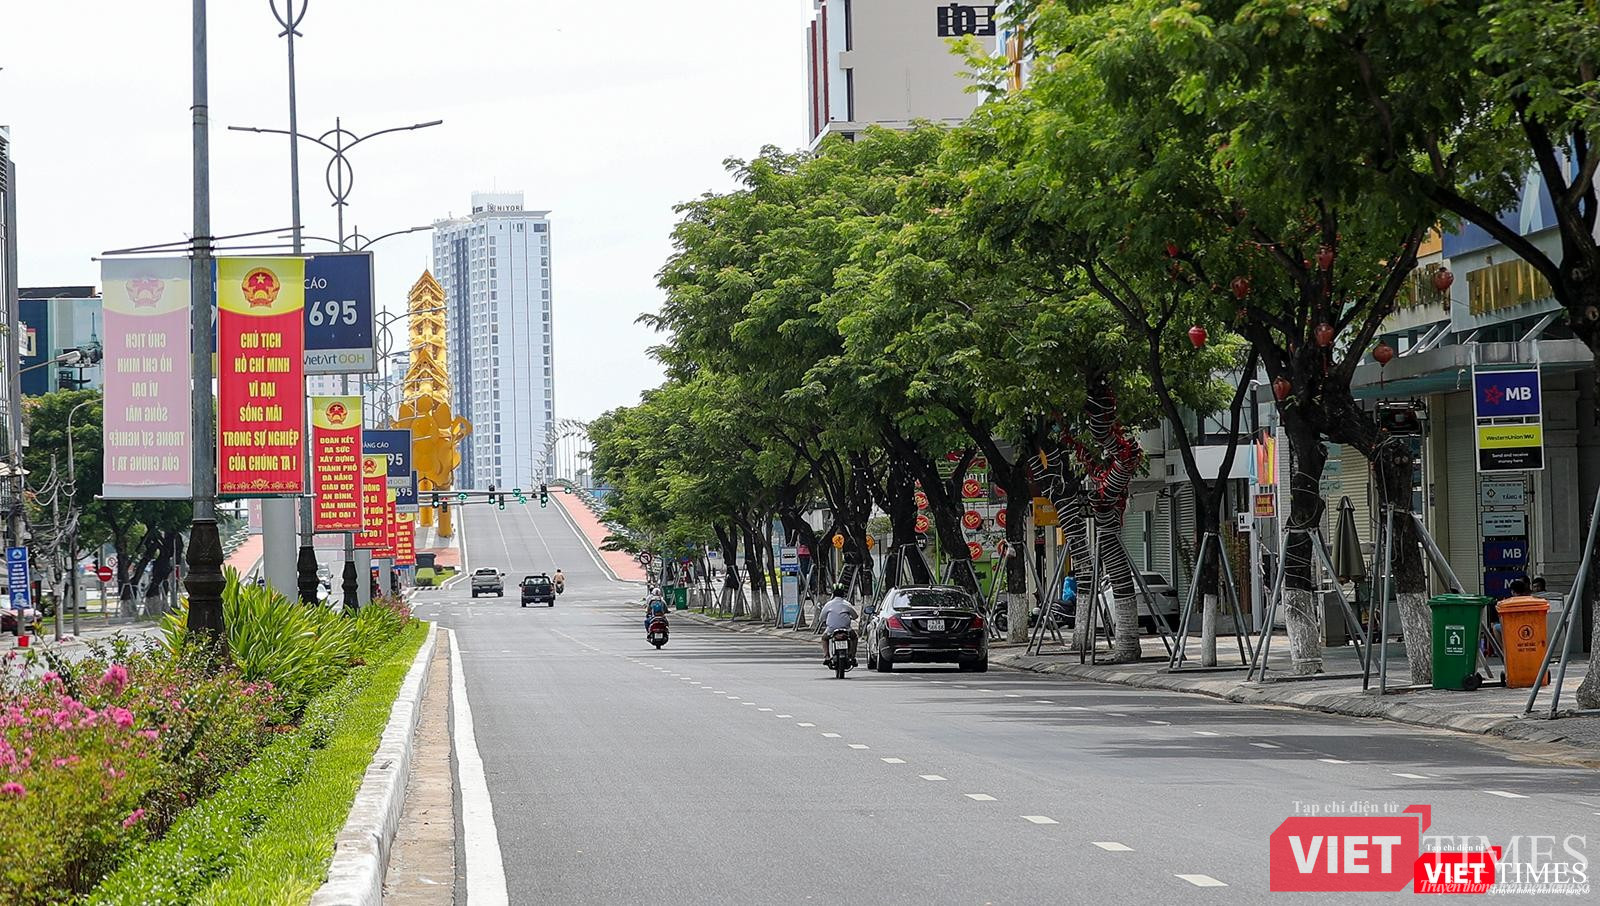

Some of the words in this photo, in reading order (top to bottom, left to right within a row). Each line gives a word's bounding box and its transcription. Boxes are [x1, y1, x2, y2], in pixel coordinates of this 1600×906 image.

[304, 276, 328, 289] CÁO
[309, 300, 358, 326] 695
[240, 330, 259, 349] CHỦ
[260, 333, 281, 351] TỊCH
[234, 353, 247, 373] HỒ
[249, 355, 265, 373] CHÍ
[266, 357, 290, 373] MINH
[338, 353, 365, 364] OOH
[260, 382, 276, 399] ĐẠI
[1505, 387, 1532, 401] MB
[239, 402, 263, 422] SỐNG
[265, 404, 282, 421] MÃI
[223, 431, 252, 447] TRONG
[254, 429, 267, 449] SỰ
[268, 428, 299, 448] NGHIỆP
[228, 453, 246, 471] CỦA
[248, 453, 278, 471] CHÚNG
[280, 455, 291, 471] TA
[1502, 548, 1522, 559] MB
